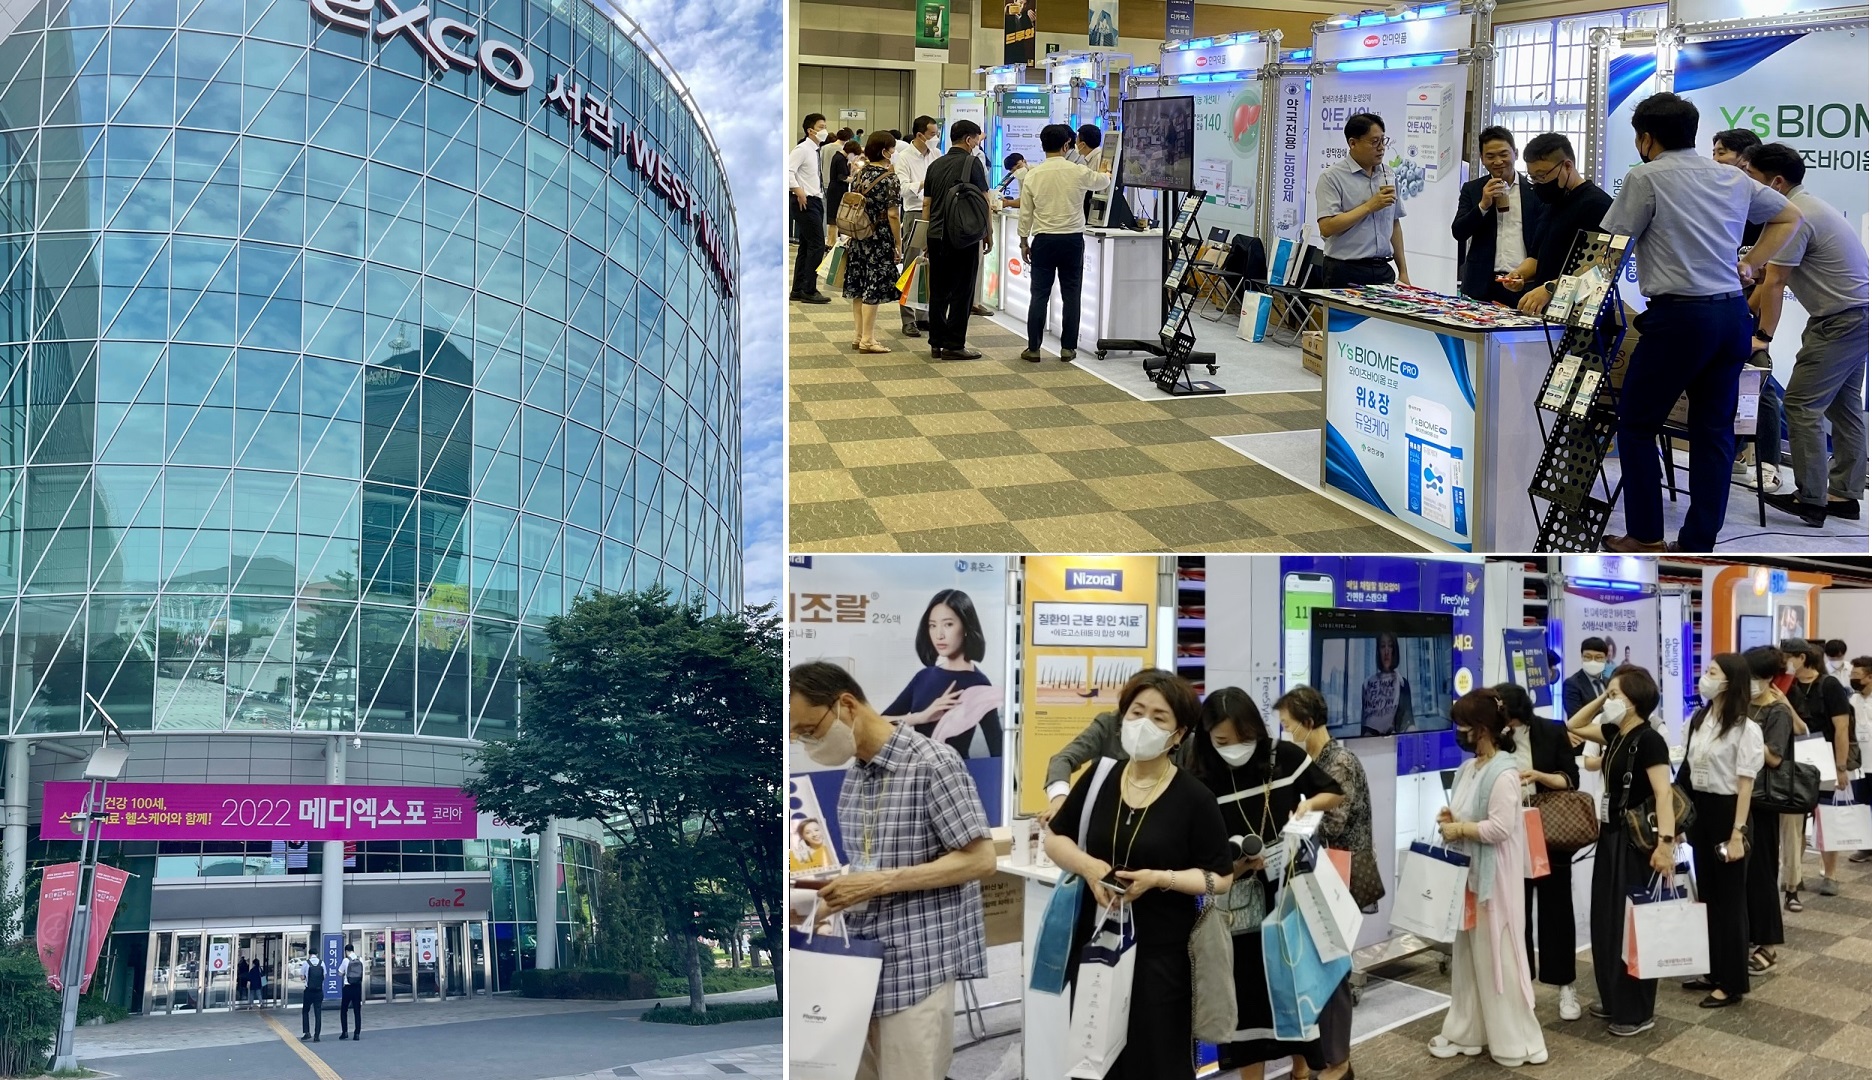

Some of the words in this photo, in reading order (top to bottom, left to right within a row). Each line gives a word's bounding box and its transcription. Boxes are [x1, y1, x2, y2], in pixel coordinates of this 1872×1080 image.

[1382, 32, 1406, 46] 한미약품
[548, 73, 617, 148] 서관
[1204, 113, 1221, 131] 140
[1284, 99, 1299, 150] 약국전용
[1407, 121, 1432, 134] 안토시안
[630, 131, 698, 223] WEST
[1283, 152, 1296, 203] 눈영양제
[1628, 258, 1636, 280] PRO
[1338, 342, 1399, 374] Y'sBIOME
[1402, 364, 1417, 376] PRO
[1348, 366, 1386, 386] 와이즈바이옴
[1387, 378, 1399, 390] 프로
[1355, 412, 1390, 440] 듀얼케어
[970, 562, 994, 572] 휴온스
[1073, 572, 1115, 586] Nizoral
[1441, 594, 1469, 605] FreeStyle
[1039, 614, 1070, 626] 질환의
[1072, 614, 1093, 626] 근본
[1096, 615, 1116, 626] 원인
[1453, 607, 1469, 616] Libre
[1627, 620, 1638, 632] 승인
[1671, 638, 1680, 677] changing
[1262, 676, 1270, 721] FreeStyle
[105, 797, 127, 810] 건강
[131, 797, 167, 811] 100세,
[221, 798, 291, 826] 2022
[299, 798, 426, 829] 메디엑스포
[432, 807, 463, 821] 코리아
[186, 812, 212, 825] 함께!
[428, 897, 450, 908] Gate
[453, 888, 466, 907] 2
[328, 939, 338, 978] 들어가는
[328, 980, 338, 990] 곳
